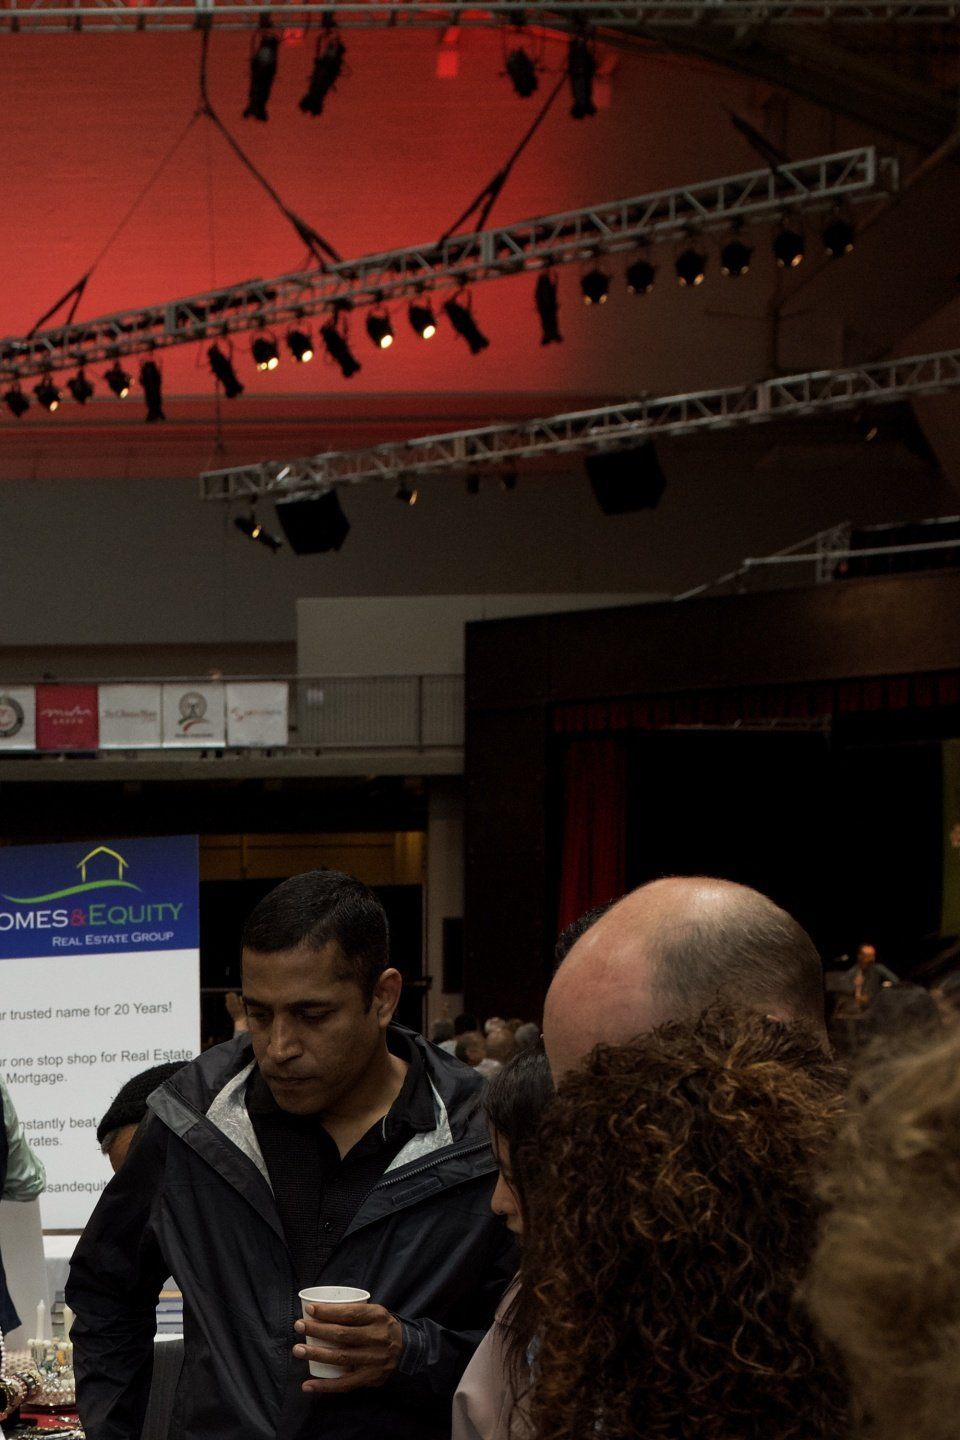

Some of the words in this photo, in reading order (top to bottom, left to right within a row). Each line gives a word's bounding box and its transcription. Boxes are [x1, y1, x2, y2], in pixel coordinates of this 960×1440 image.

[10, 1006, 52, 1020] trusted
[55, 1008, 90, 1019] name
[93, 1004, 111, 1017] for
[114, 1003, 130, 1016] 20
[134, 1000, 172, 1015] Years!
[10, 1056, 33, 1067] one
[37, 1054, 63, 1068] stop
[67, 1052, 97, 1067] shop
[100, 1051, 116, 1064] for
[121, 1049, 149, 1062] Real
[153, 1048, 194, 1062] Estate
[6, 1071, 67, 1086] Mortgage.
[19, 1117, 65, 1132] nstantly
[69, 1116, 97, 1129] beat
[28, 1135, 63, 1147] rates.
